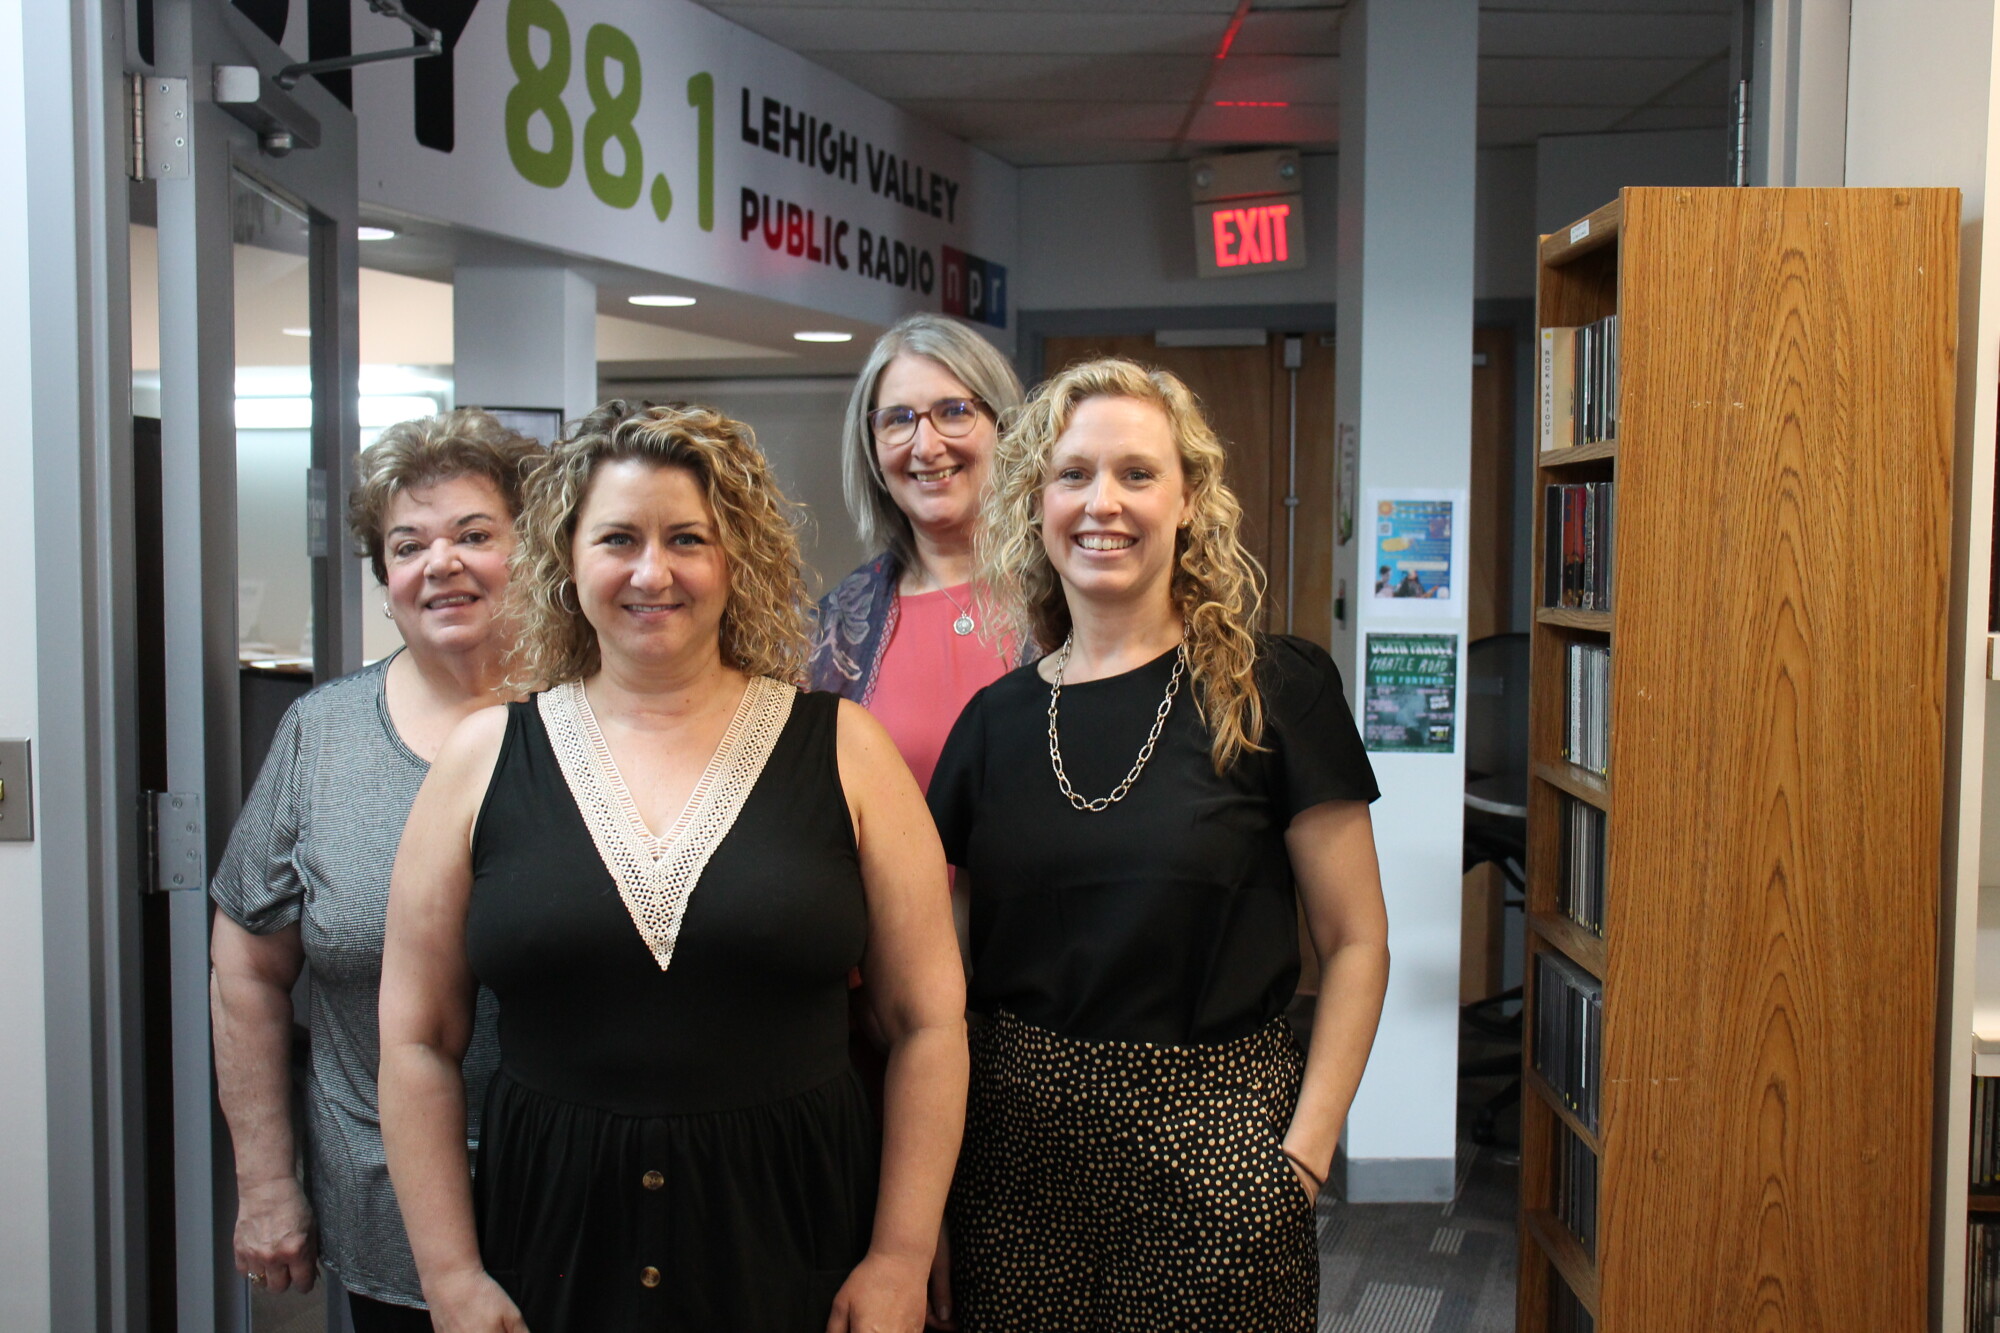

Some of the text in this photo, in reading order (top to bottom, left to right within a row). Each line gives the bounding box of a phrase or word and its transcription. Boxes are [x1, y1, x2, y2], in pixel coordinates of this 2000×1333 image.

[505, 0, 714, 232] 88.1
[741, 87, 959, 223] LEHIGH VALLEY
[741, 186, 934, 296] PUBLIC RADIO
[946, 263, 1001, 317] npr
[1212, 204, 1291, 268] EXIT
